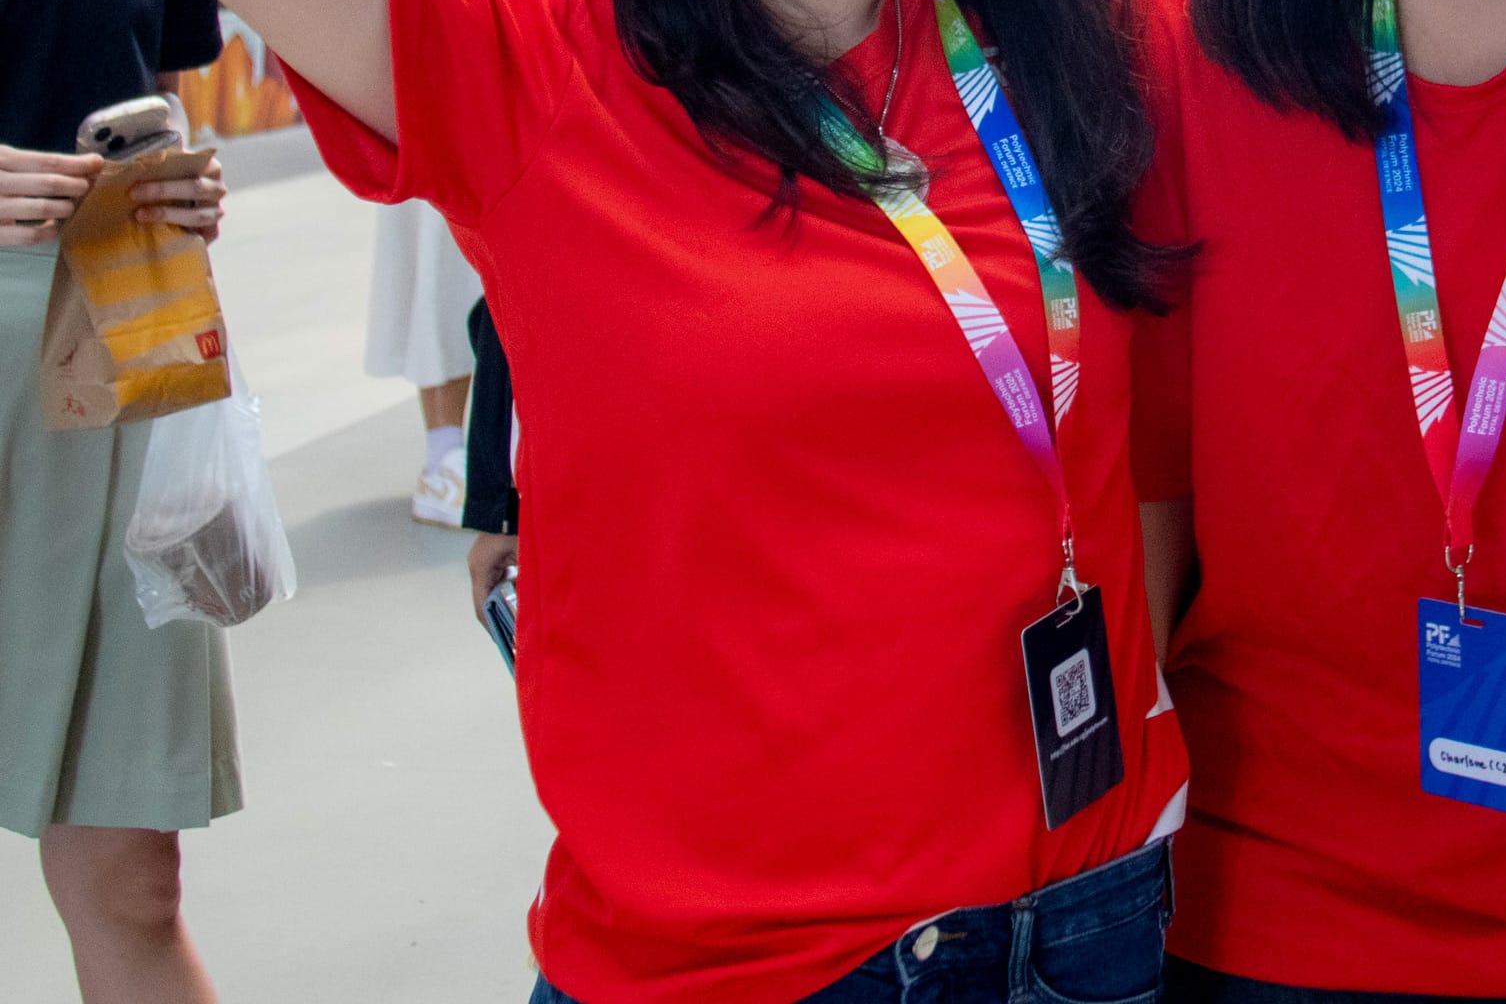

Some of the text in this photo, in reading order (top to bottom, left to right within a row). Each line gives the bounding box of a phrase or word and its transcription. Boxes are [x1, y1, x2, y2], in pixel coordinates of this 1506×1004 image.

[991, 141, 1018, 189] TOTAL DEFENCE
[998, 137, 1028, 187] Forum 2024
[1007, 133, 1038, 185] Polytechnic
[1391, 168, 1403, 192] 2024
[1396, 133, 1413, 191] Polytechnic
[920, 247, 944, 272] PF
[1062, 296, 1077, 319] PF
[1419, 308, 1437, 331] PF
[993, 376, 1026, 428] Polytechnic
[1003, 371, 1033, 425] Forum 2024
[1465, 375, 1489, 434] Polytechnic
[1477, 378, 1498, 435] Forum 2024
[1426, 622, 1451, 644] PF
